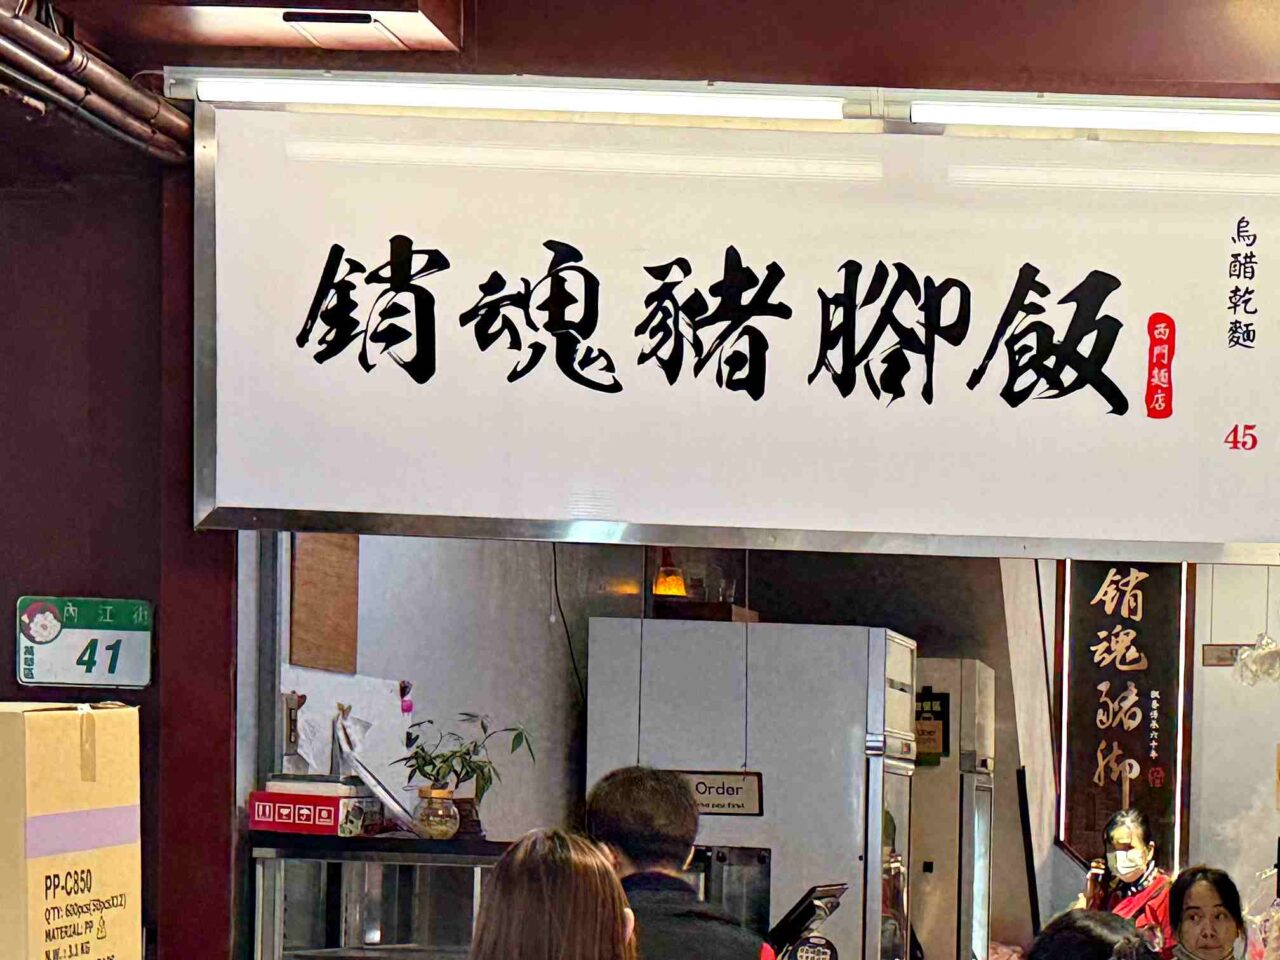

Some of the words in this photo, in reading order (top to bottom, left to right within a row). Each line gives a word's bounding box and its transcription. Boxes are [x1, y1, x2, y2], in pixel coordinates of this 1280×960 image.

[1228, 216, 1257, 349] 烏醋乾麵
[296, 234, 1131, 417] 銷魂豬腳飯
[1224, 424, 1258, 451] 45
[76, 639, 122, 674] 41
[695, 781, 743, 795] Order
[45, 869, 92, 900] PP-C850
